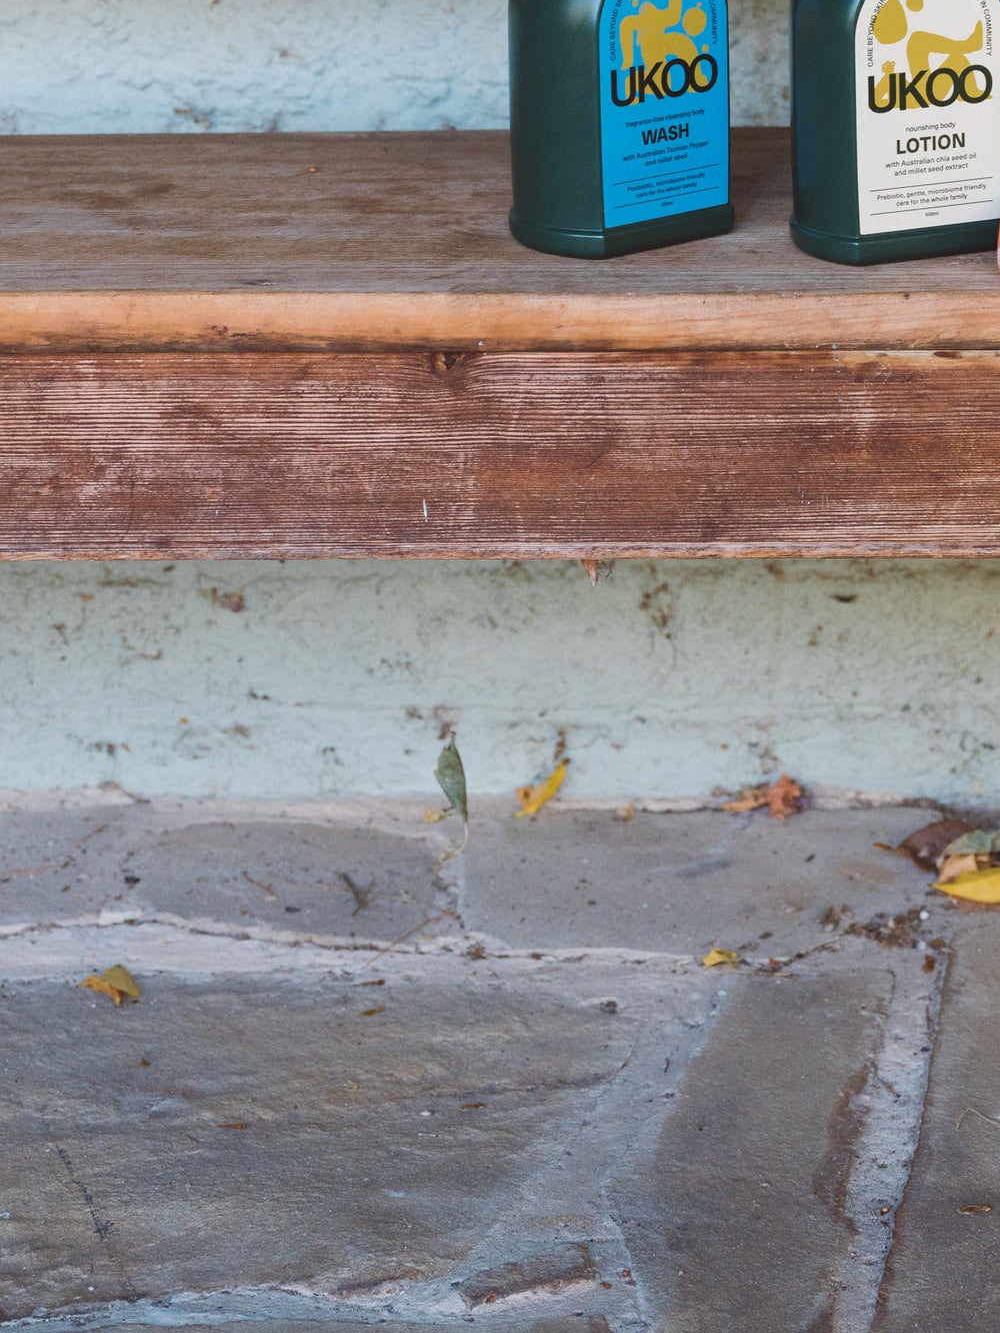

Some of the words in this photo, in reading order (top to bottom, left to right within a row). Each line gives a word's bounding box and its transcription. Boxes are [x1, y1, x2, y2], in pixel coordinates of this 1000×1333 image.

[980, 0, 987, 9] IN
[610, 8, 619, 39] BEYOND
[867, 15, 878, 46] BEYOND
[983, 8, 992, 56] COMMUNITY
[611, 54, 718, 107] UKOO
[867, 64, 993, 114] UKOO
[625, 115, 665, 129] fragrance-free
[665, 110, 691, 122] cleansing
[691, 108, 706, 118] body
[905, 123, 939, 133] nourishing
[939, 121, 956, 130] body
[641, 122, 689, 146] WASH
[896, 132, 965, 155] LOTION
[622, 153, 635, 162] with
[636, 148, 666, 160] Australian
[688, 140, 709, 152] Pepper
[645, 158, 656, 166] and
[657, 155, 673, 165] millet
[674, 153, 688, 162] seed
[885, 161, 900, 169] with
[901, 157, 935, 167] Australian
[936, 155, 950, 163] chia
[951, 154, 968, 162] seed
[968, 152, 977, 160] oil
[894, 169, 907, 177] and
[908, 166, 927, 175] millet
[927, 165, 944, 173] seed
[945, 162, 969, 171] extract
[655, 177, 686, 188] microbiome
[686, 171, 706, 183] friendly
[636, 191, 648, 199] care
[648, 188, 656, 197] for
[656, 187, 665, 195] the
[665, 184, 682, 194] whole
[682, 181, 698, 191] family
[877, 192, 906, 201] Prebiotic,
[906, 190, 927, 199] gentle,
[928, 186, 963, 195] microbiome
[963, 183, 987, 192] friendly
[930, 195, 949, 203] whole
[949, 193, 968, 202] family
